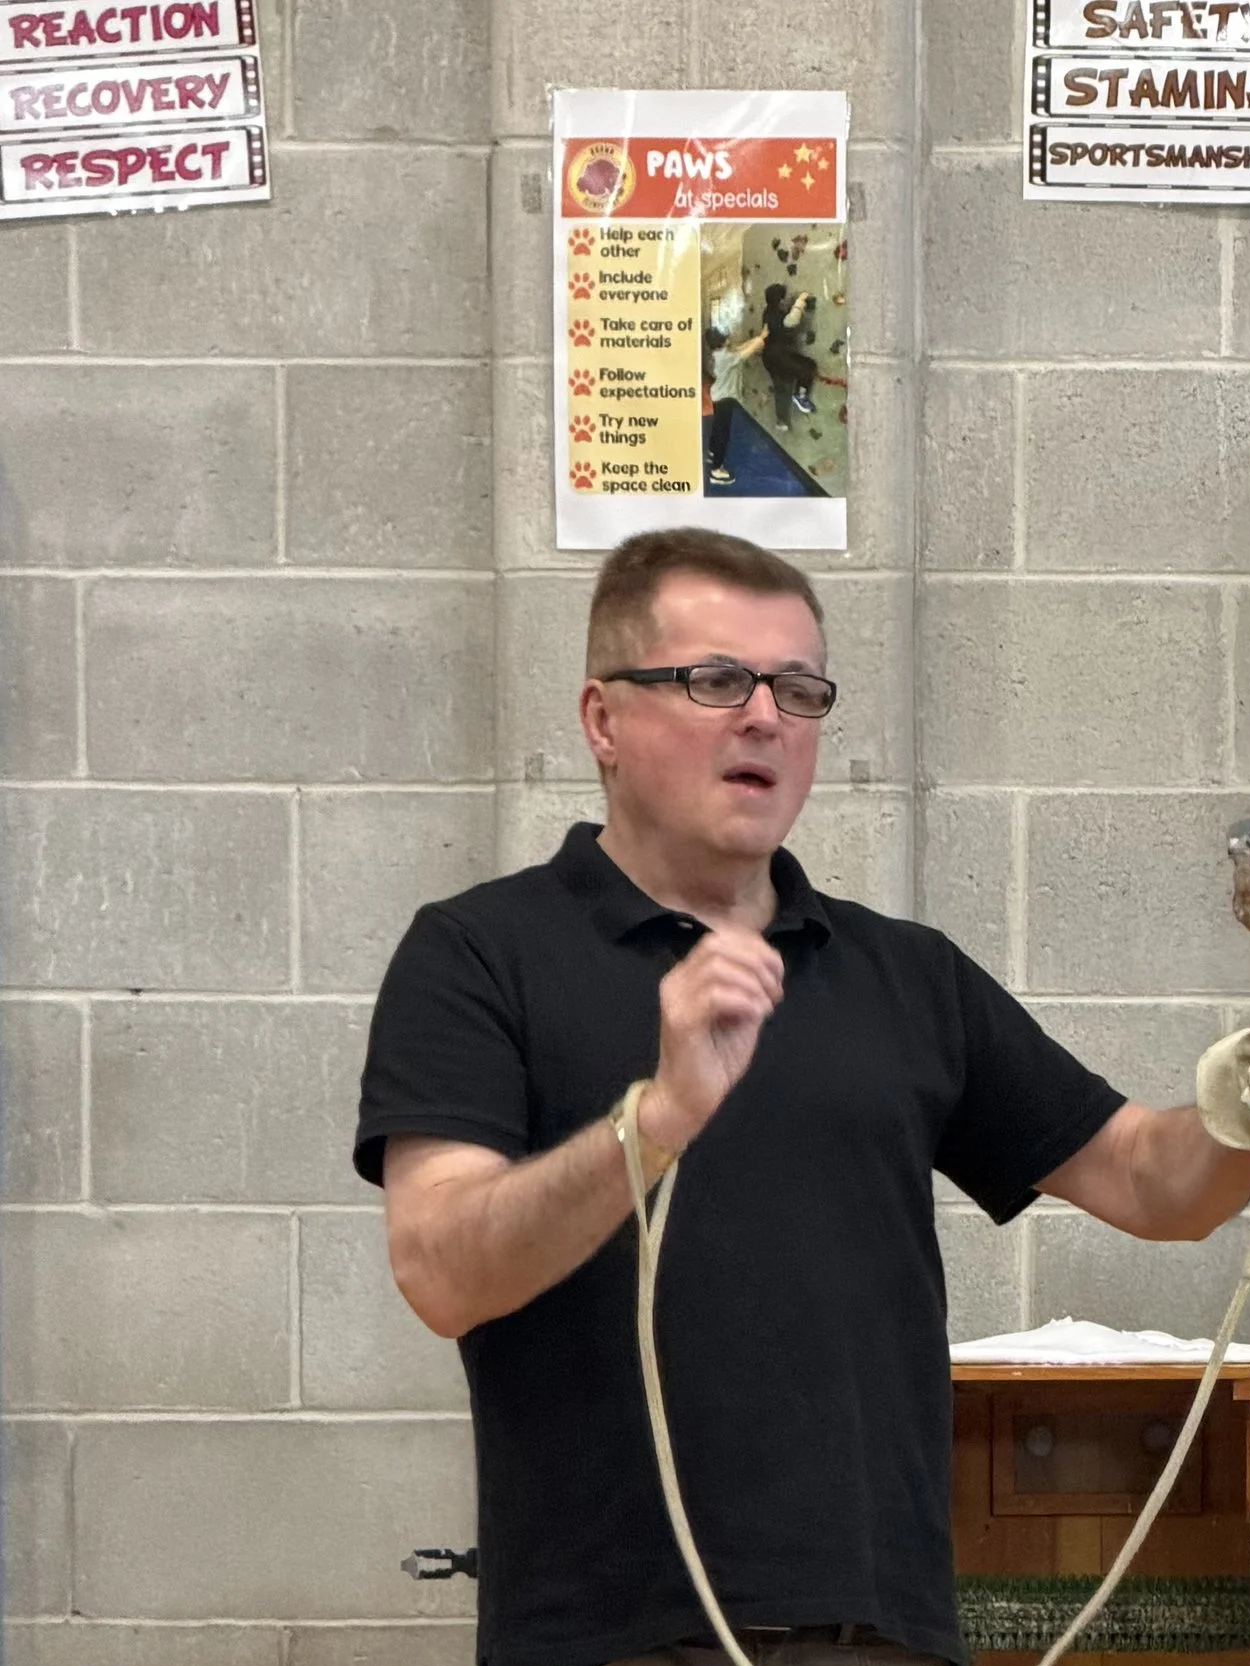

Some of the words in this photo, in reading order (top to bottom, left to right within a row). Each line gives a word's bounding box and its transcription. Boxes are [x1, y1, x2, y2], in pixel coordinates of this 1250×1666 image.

[8, 2, 220, 48] REACTION
[9, 72, 231, 120] RECOVERY
[20, 141, 230, 190] RESPECT
[646, 150, 733, 180] PAWS
[702, 187, 779, 210] specials
[600, 227, 633, 243] Help
[638, 227, 674, 241] each
[600, 245, 641, 258] other
[599, 270, 652, 284] Include
[599, 289, 668, 303] everyone
[600, 318, 636, 332] Take
[640, 320, 673, 332] care
[677, 318, 693, 331] of
[600, 334, 672, 348] materials
[599, 367, 646, 381] Follow
[599, 385, 696, 400] expectations
[599, 413, 623, 430] Try
[629, 416, 658, 428] new
[599, 431, 646, 447] things
[601, 461, 639, 477] Keep
[644, 461, 668, 475] the
[602, 479, 647, 494] space
[652, 477, 691, 492] clean
